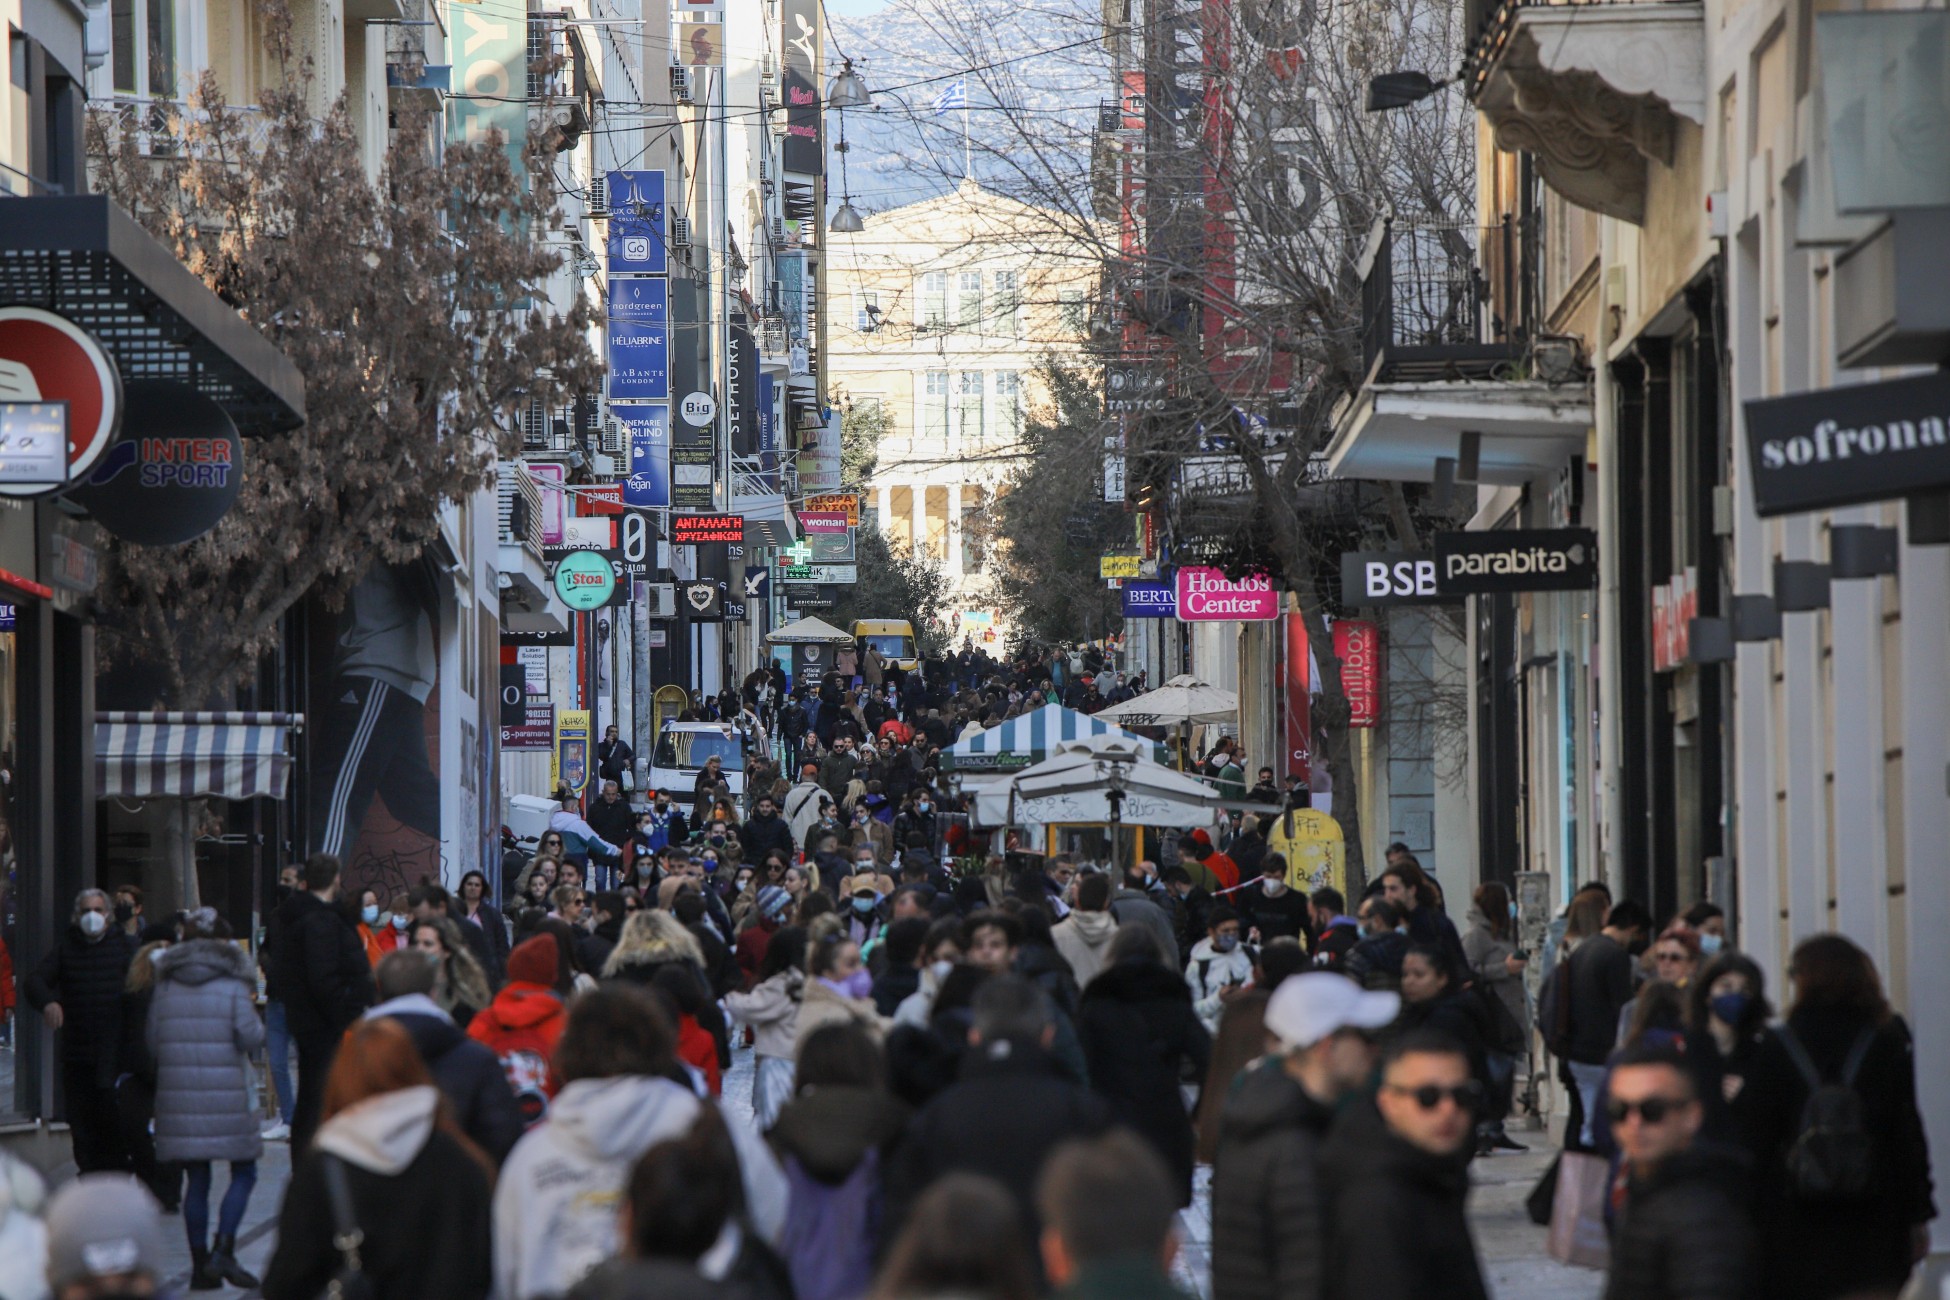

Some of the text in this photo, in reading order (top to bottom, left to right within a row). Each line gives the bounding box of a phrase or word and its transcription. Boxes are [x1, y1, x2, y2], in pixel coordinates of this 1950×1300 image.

[627, 241, 645, 253] Go
[612, 302, 662, 311] nordgreen
[612, 335, 663, 346] HÉLIABRINE
[729, 338, 740, 433] SEPHORA
[686, 402, 710, 415] Big
[631, 427, 663, 438] RLIND
[1762, 414, 1950, 470] sofrona
[141, 438, 232, 463] INTER
[140, 463, 232, 488] SPORT
[811, 495, 852, 504] ΑΓΟΡΑ
[806, 504, 857, 512] ΧΡΥΣΟΥ
[675, 517, 743, 529] ΑΝΤΑΛΛΑΓΗ
[806, 519, 845, 527] woman
[675, 531, 743, 542] ΧΡΥΣΑΦΙΚΩΝ
[1447, 547, 1568, 580] parabita
[566, 573, 603, 585] iStoa
[1366, 560, 1437, 598] BSB
[1187, 592, 1262, 614] Center
